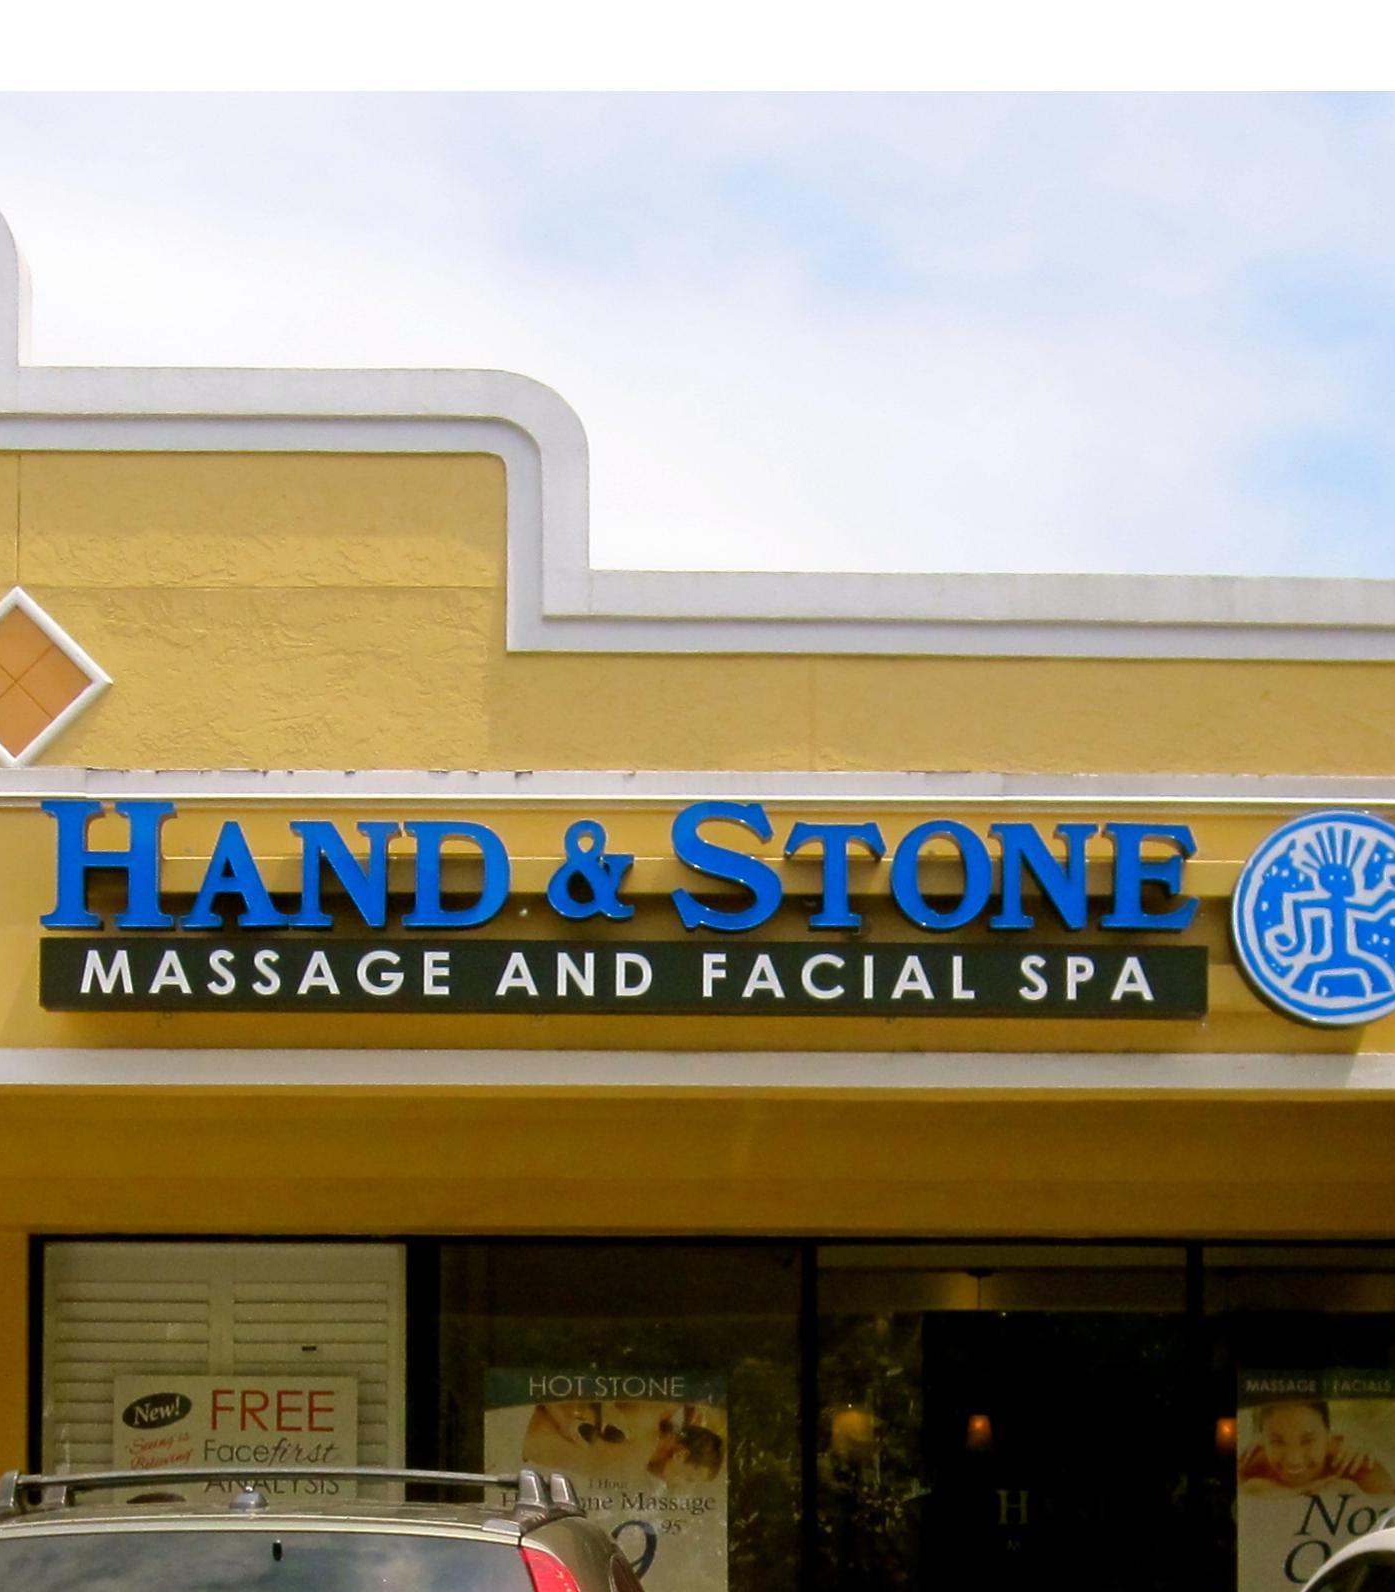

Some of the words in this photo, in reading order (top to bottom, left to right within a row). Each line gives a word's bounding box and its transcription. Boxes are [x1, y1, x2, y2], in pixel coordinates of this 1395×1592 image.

[40, 800, 509, 931] HAND
[546, 819, 635, 922] &
[670, 800, 1199, 934] STONE
[80, 948, 452, 997] MASSAGE
[495, 951, 654, 999] AND
[702, 951, 978, 1001] FACIAL
[1019, 953, 1156, 1002] SPA
[528, 1376, 585, 1398] HOT
[594, 1376, 685, 1398] STONE
[1245, 1379, 1317, 1393] MASSAGE
[132, 1398, 181, 1426] New!
[211, 1389, 335, 1432] FREE
[203, 1437, 339, 1467] Facefirst
[621, 1492, 716, 1515] Massage
